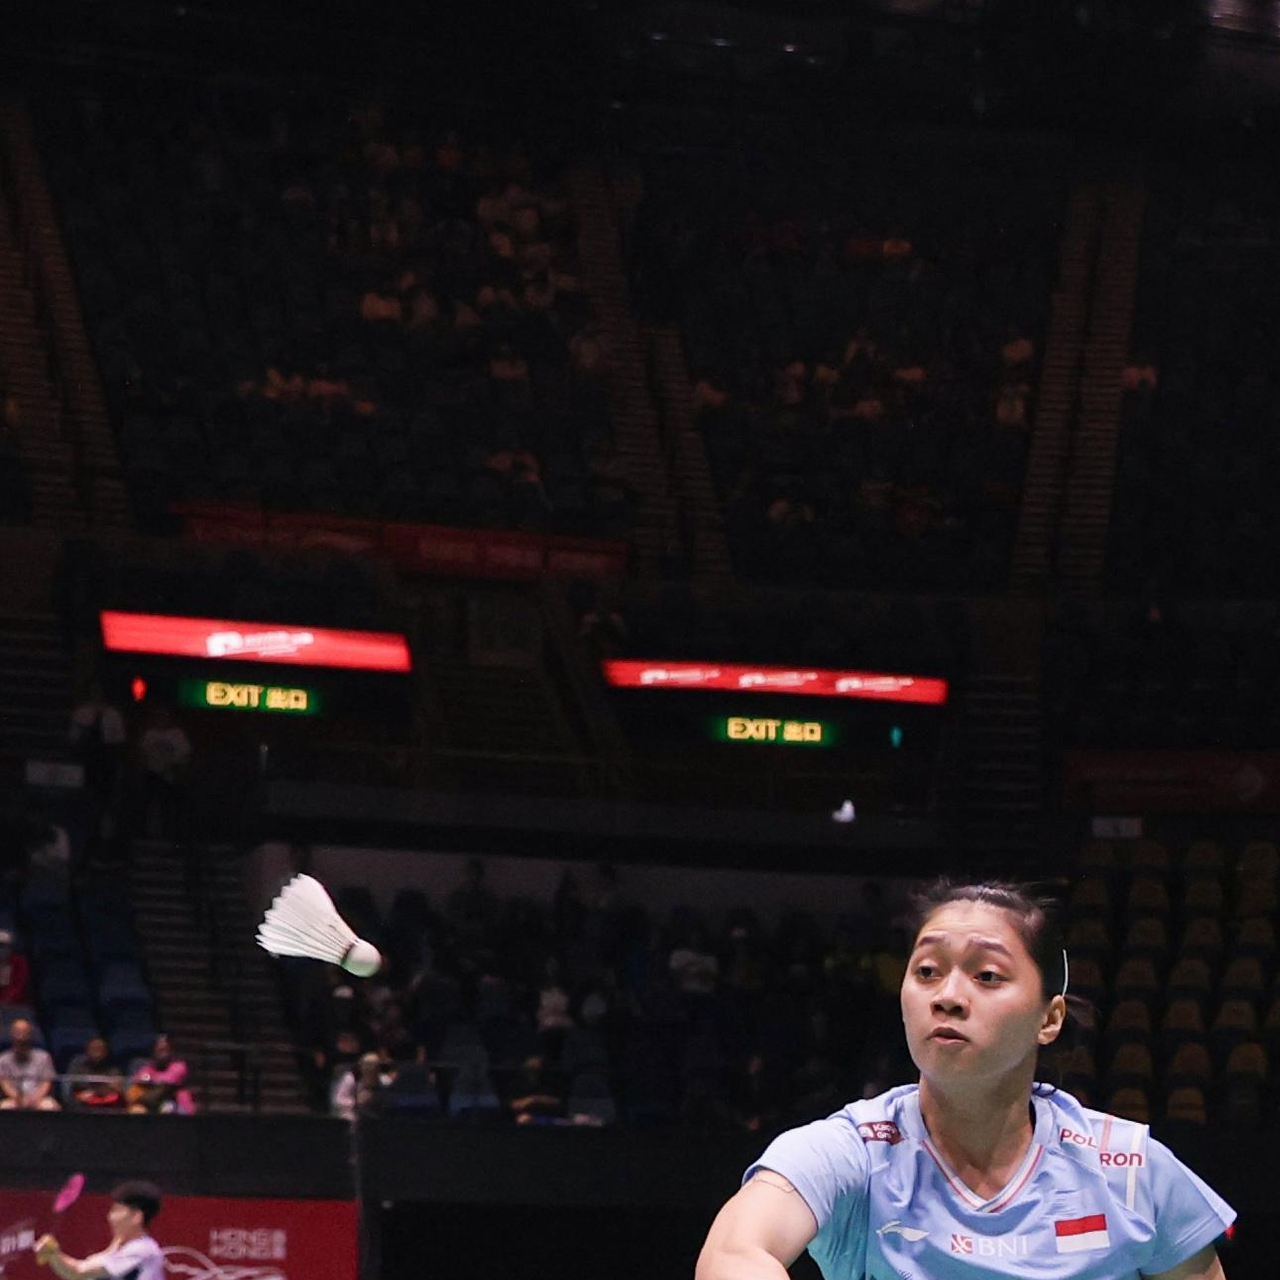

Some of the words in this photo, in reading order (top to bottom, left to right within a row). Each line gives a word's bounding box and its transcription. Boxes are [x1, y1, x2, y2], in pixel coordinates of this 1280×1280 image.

[206, 682, 261, 707] EXIT
[727, 717, 780, 740] EXIT
[978, 1237, 1028, 1256] BNI
